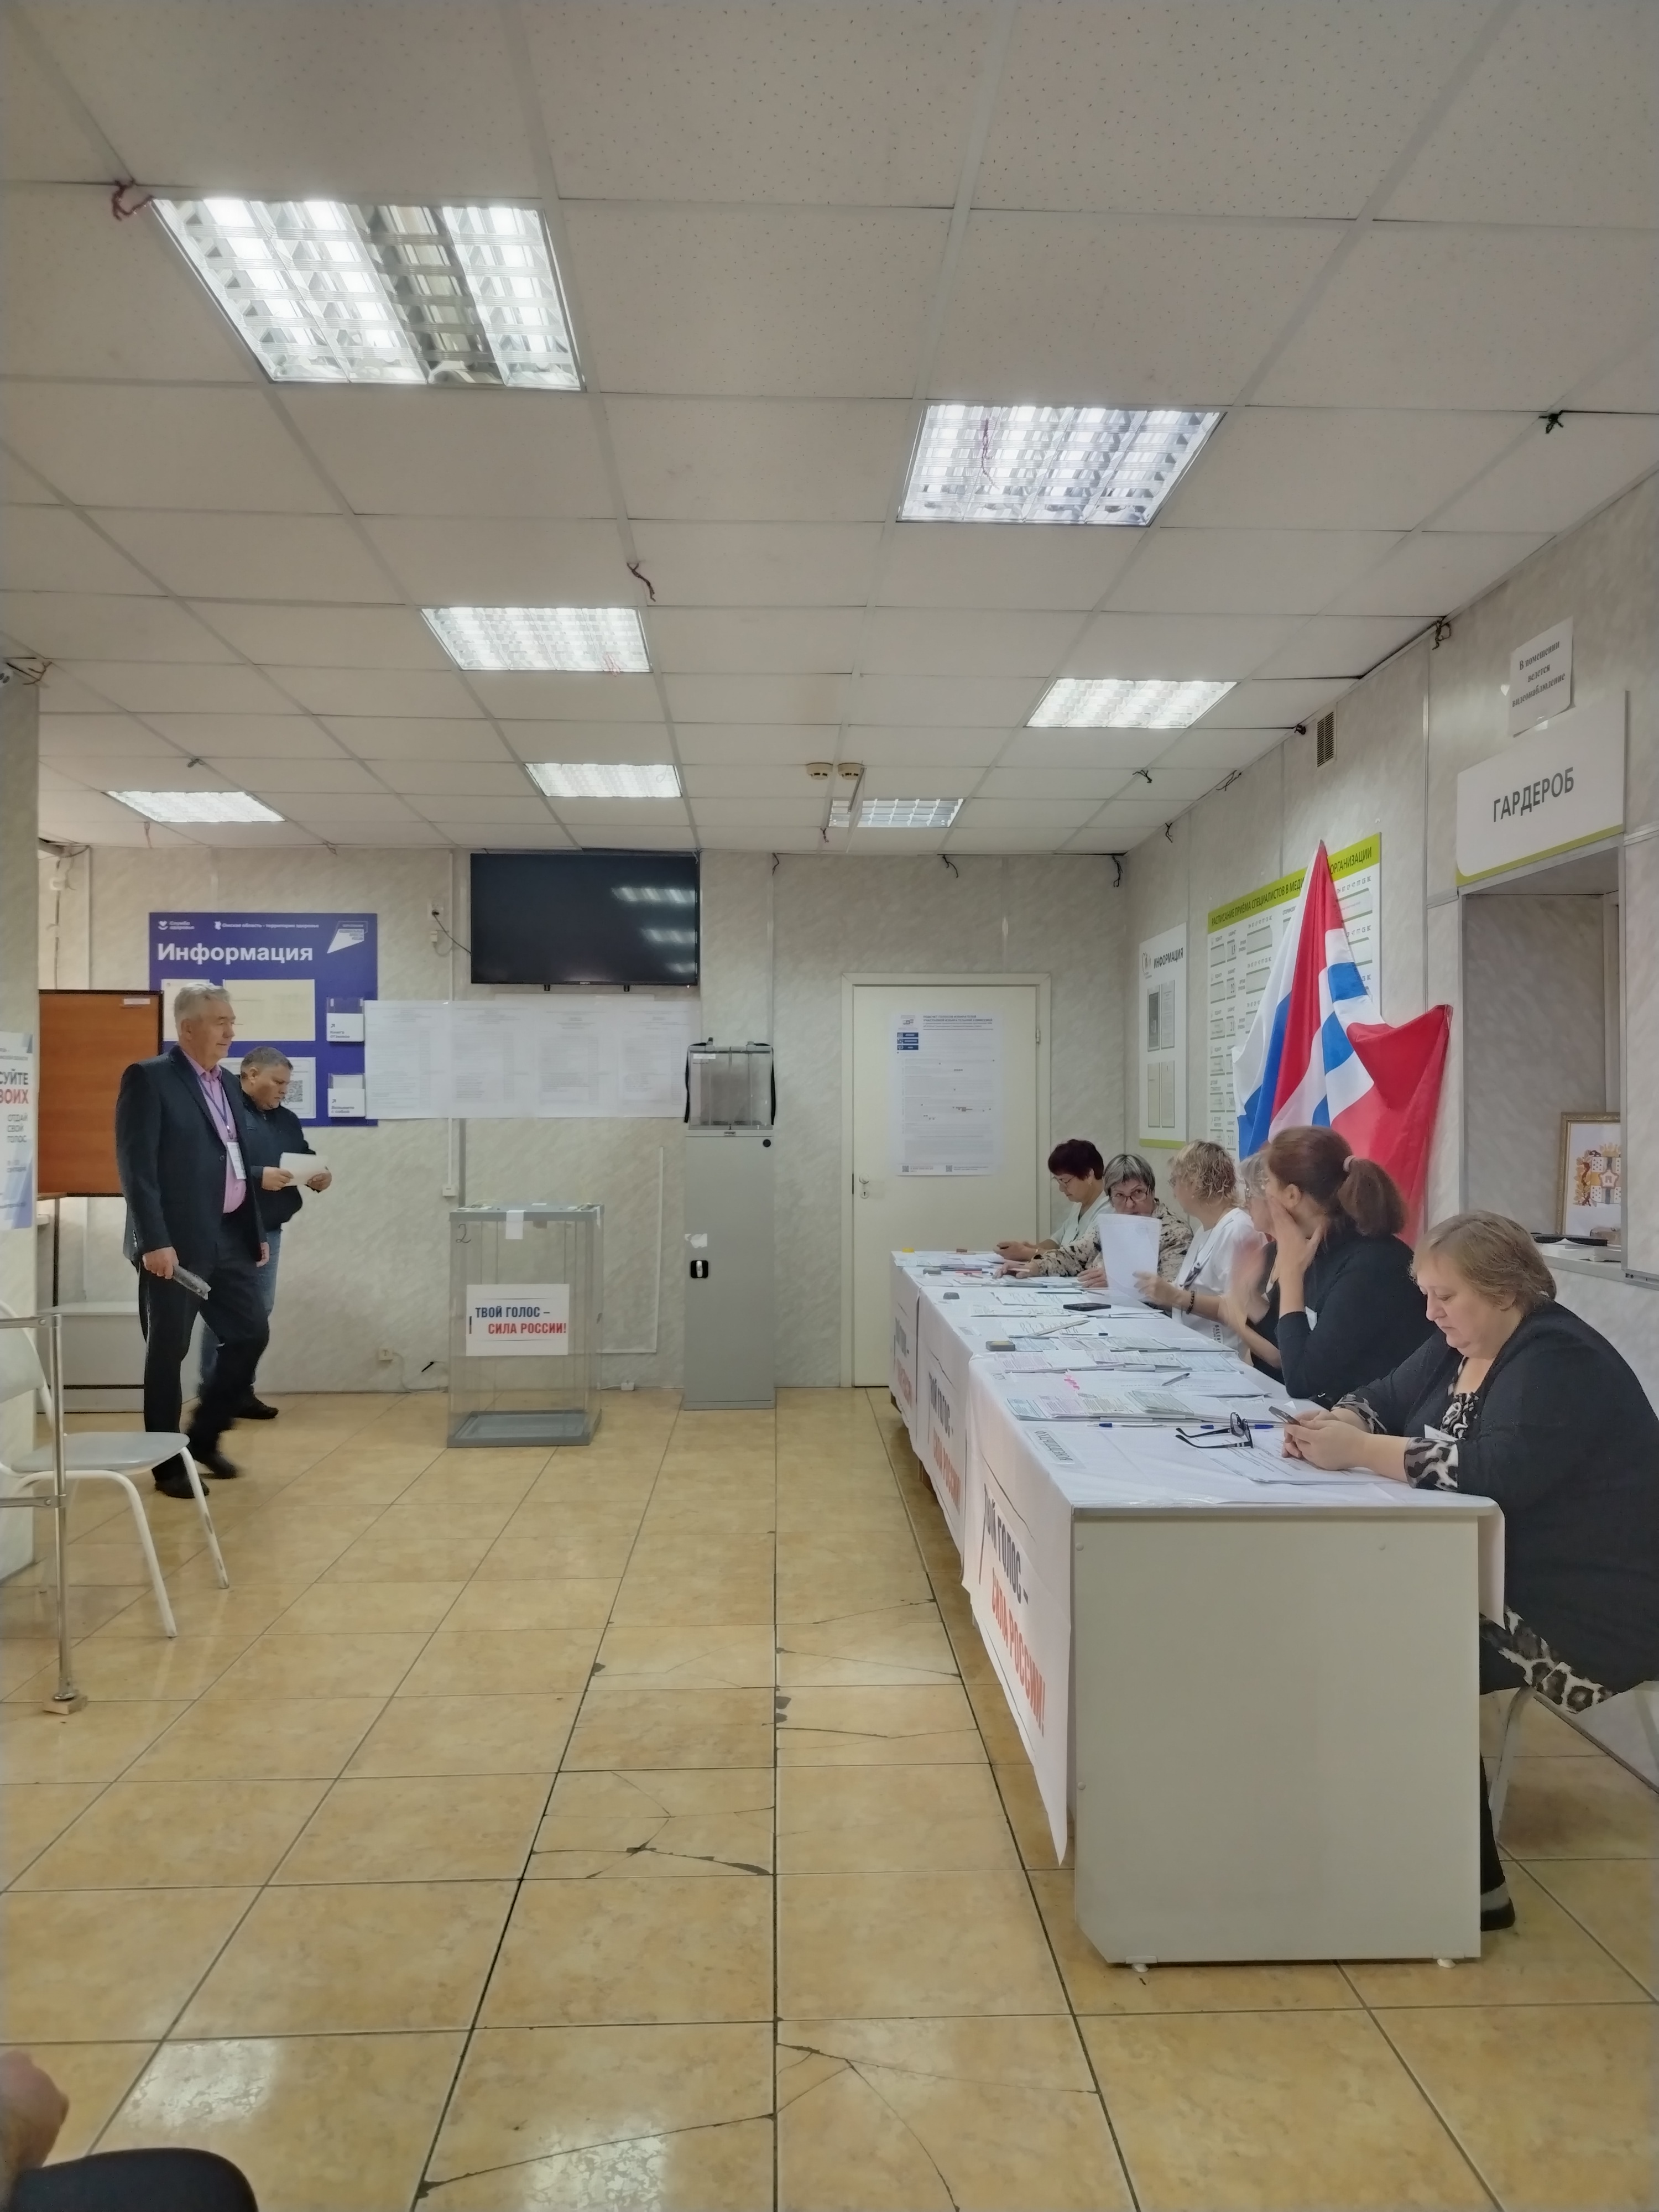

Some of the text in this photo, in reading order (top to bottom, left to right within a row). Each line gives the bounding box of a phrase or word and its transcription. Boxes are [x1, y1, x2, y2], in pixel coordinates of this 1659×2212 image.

[1519, 640, 1560, 671] В помещении
[1528, 664, 1550, 683] ведется
[1512, 672, 1566, 708] видеонаблюдение
[1493, 766, 1574, 823] ГАРДЕРОБ
[1211, 907, 1234, 926] РАСПИСАНИЕ
[1234, 900, 1251, 916] ПРИЁМА
[1251, 885, 1285, 909] СПЕЦИАЛИСТОВ
[1286, 884, 1289, 894] В
[1330, 846, 1372, 875] ОРГАНИЗАЦИИ
[158, 943, 314, 965] Информация
[1154, 947, 1183, 969] ИНФОРМАЦИЯ
[455, 1223, 471, 1244] 2
[475, 1306, 502, 1318] ТВОЙ
[505, 1306, 540, 1318] ГОЛОС
[488, 1322, 567, 1334] СИЛА РОССИИ!
[998, 1515, 1021, 1605] ГОЛОС
[992, 1567, 1046, 1739] СИЛА РОССИИ!
